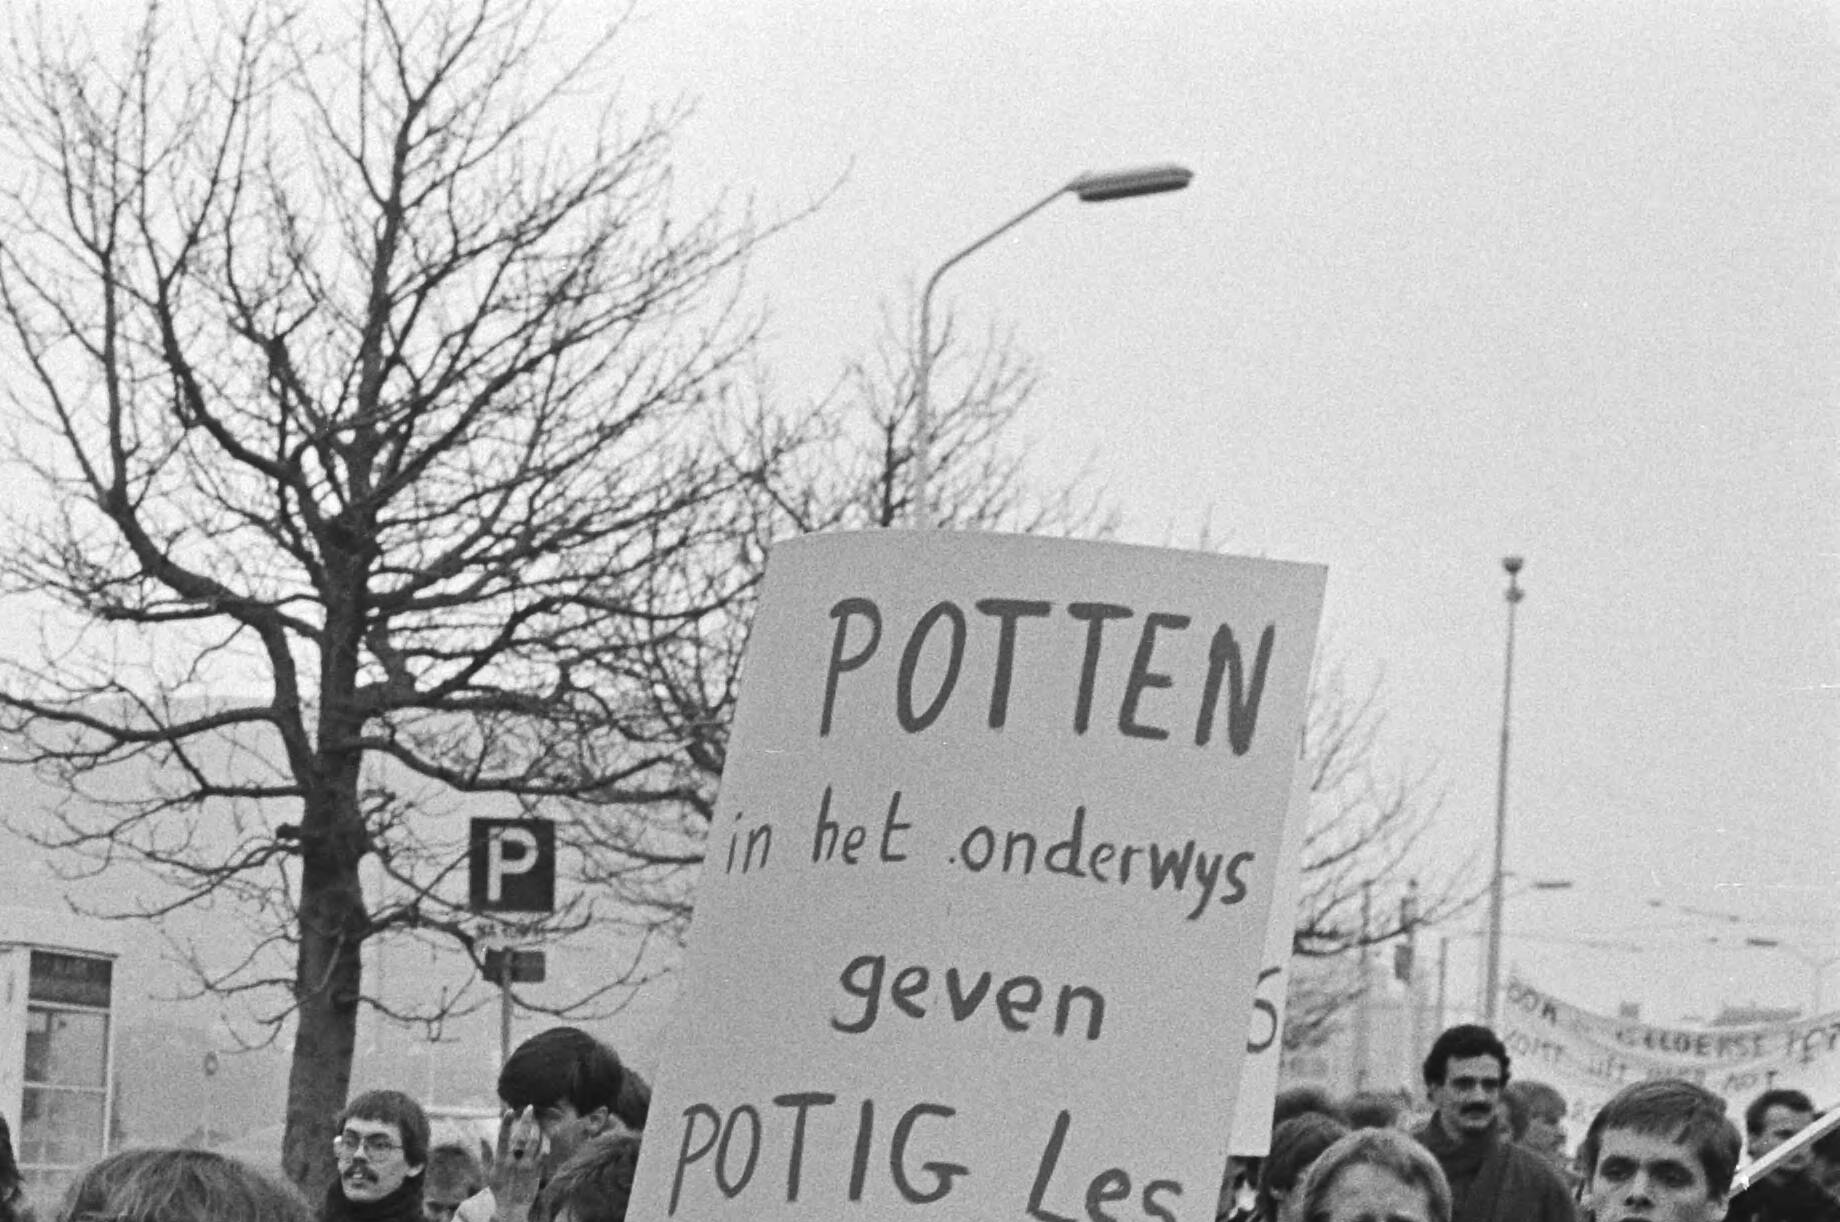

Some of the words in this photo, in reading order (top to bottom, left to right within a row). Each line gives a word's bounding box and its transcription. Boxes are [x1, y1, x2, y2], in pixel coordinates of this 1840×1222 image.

[819, 597, 1275, 756] POTTEN
[487, 826, 539, 902] P
[725, 813, 773, 874] in
[811, 784, 913, 866] het
[830, 953, 1106, 1042] geven
[668, 1091, 969, 1216] POTIG
